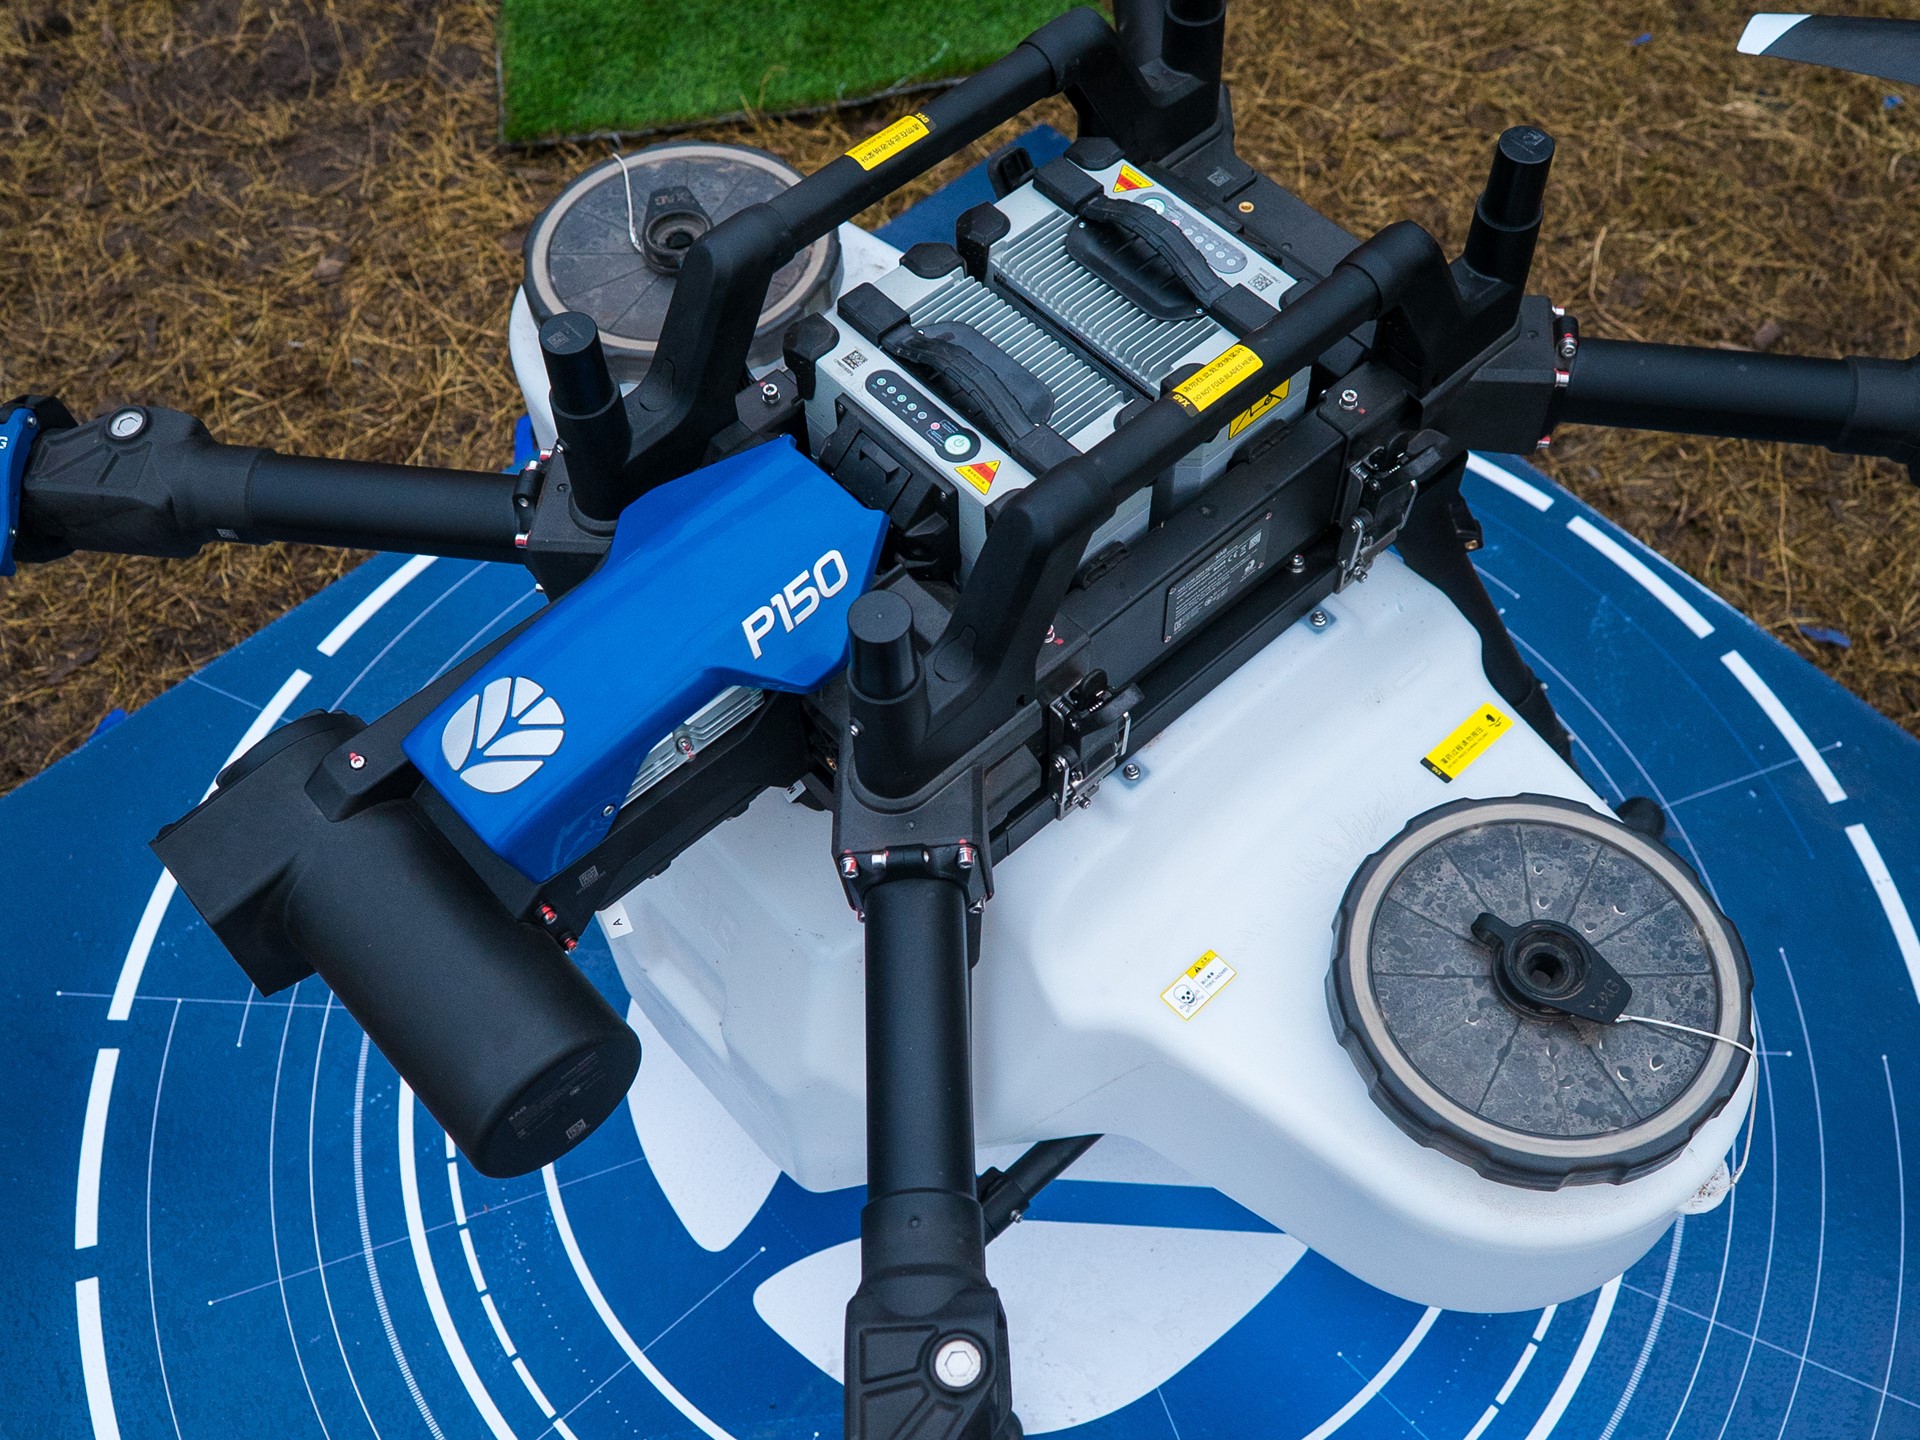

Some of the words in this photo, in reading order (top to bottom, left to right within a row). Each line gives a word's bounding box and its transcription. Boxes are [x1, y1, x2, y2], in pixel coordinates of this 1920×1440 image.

[1193, 394, 1202, 403] DO
[1201, 386, 1212, 397] NOT
[1211, 377, 1225, 389] FOLD
[1224, 365, 1243, 383] BLADES
[1242, 355, 1256, 367] HERE
[1172, 393, 1191, 408] XAG
[741, 549, 848, 661] P150
[612, 918, 623, 926] A
